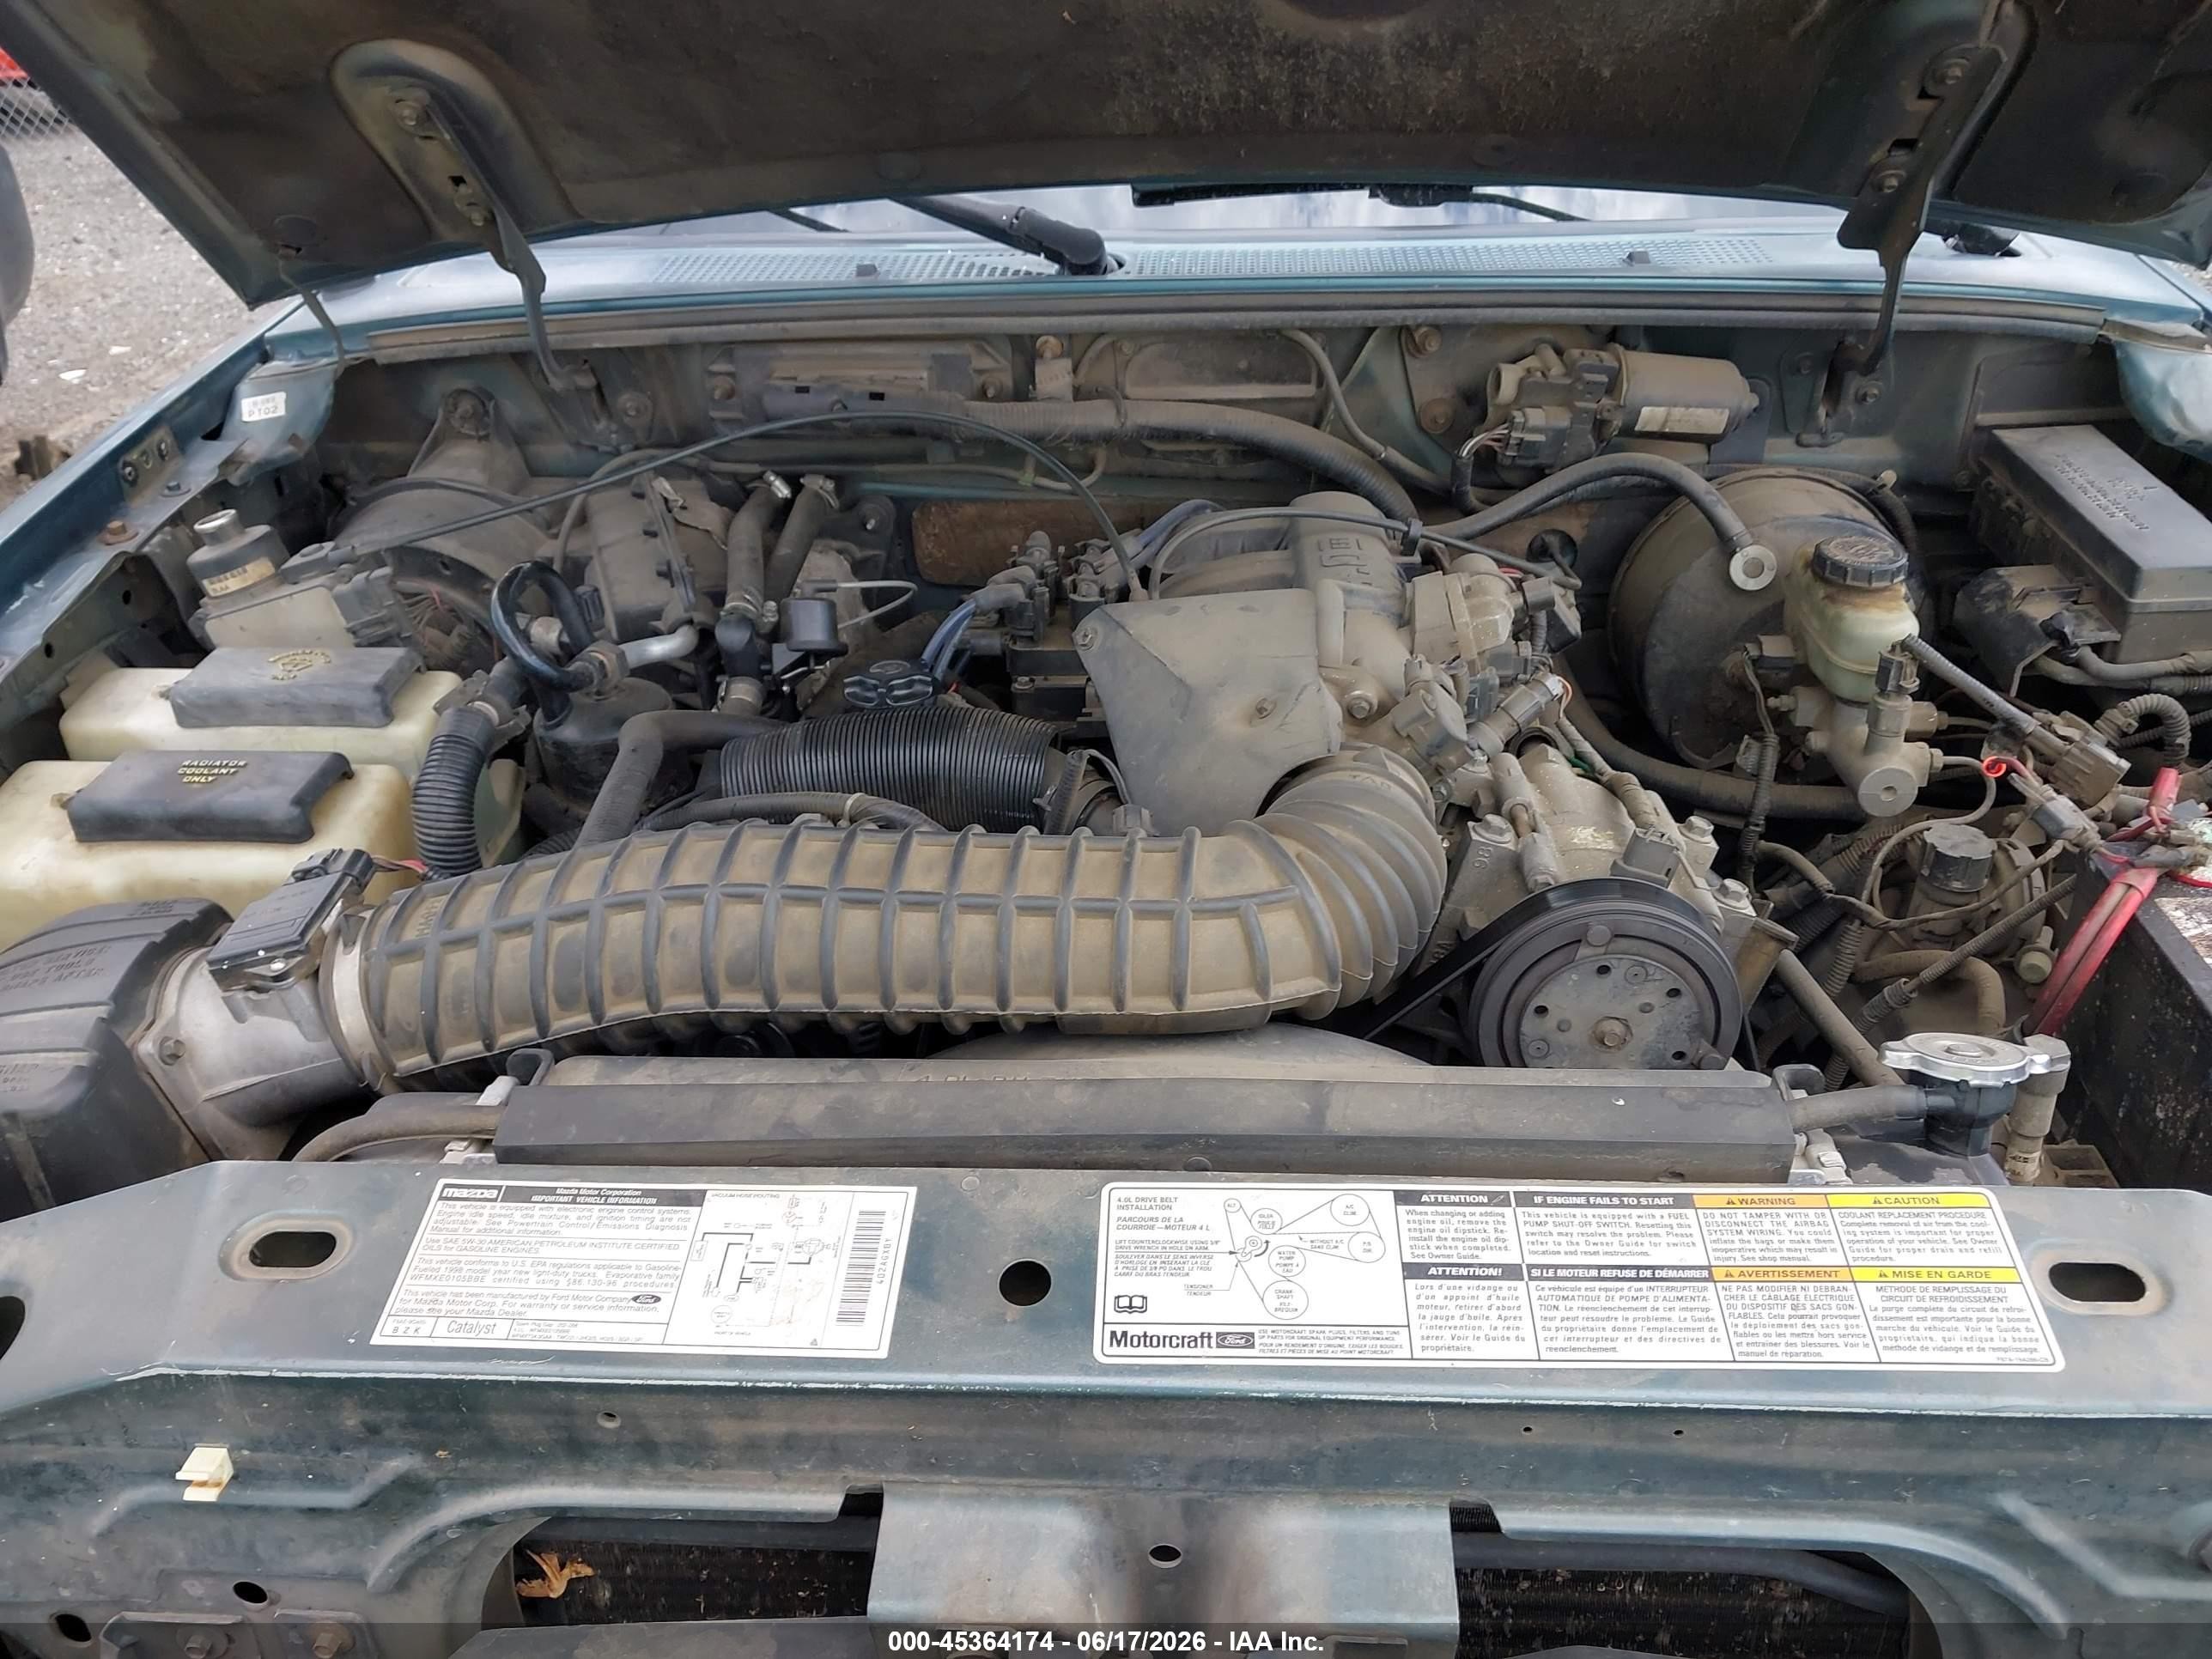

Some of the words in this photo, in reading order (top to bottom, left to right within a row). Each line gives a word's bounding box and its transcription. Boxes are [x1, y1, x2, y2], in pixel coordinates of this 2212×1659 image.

[441, 1188, 500, 1198] mazda
[1533, 1195, 1544, 1204] IF
[1546, 1195, 1588, 1204] ENGINE
[1638, 1196, 1675, 1205] START
[1430, 1209, 1467, 1218] changing
[1590, 1212, 1633, 1220] equipped
[1426, 1267, 1503, 1276] ATTENTION!
[1541, 1268, 1556, 1277] LE
[1556, 1268, 1599, 1277] MOTEUR
[1599, 1268, 1638, 1277] REFUSE
[1638, 1269, 1653, 1278] DE
[1653, 1267, 1710, 1278] DÉMARRER
[1735, 1269, 1842, 1278] AVERTISSEMENT
[593, 1295, 633, 1304] Company
[520, 1301, 559, 1310] warranty
[393, 1307, 425, 1316] please
[444, 1320, 498, 1338] Catalyst
[1109, 1330, 1214, 1349] Motorcraft
